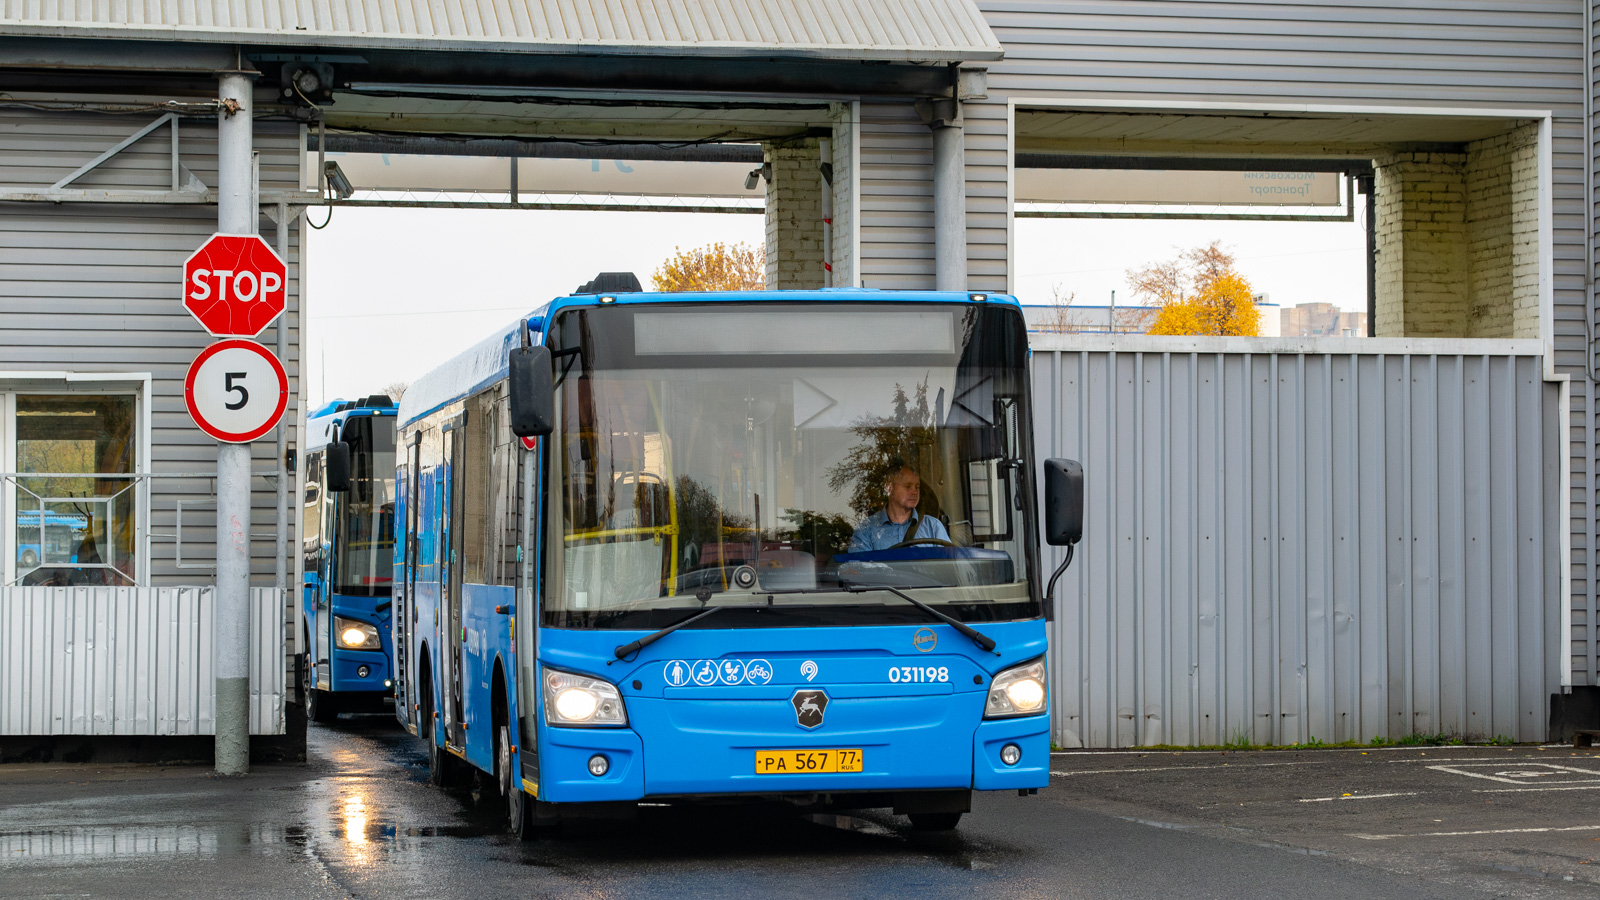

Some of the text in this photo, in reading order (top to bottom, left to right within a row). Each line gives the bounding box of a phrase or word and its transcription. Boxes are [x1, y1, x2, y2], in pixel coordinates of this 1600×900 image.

[190, 268, 281, 302] STOP
[225, 372, 249, 410] 5
[889, 667, 949, 683] 031198
[796, 753, 828, 770] 567
[839, 751, 856, 765] 77
